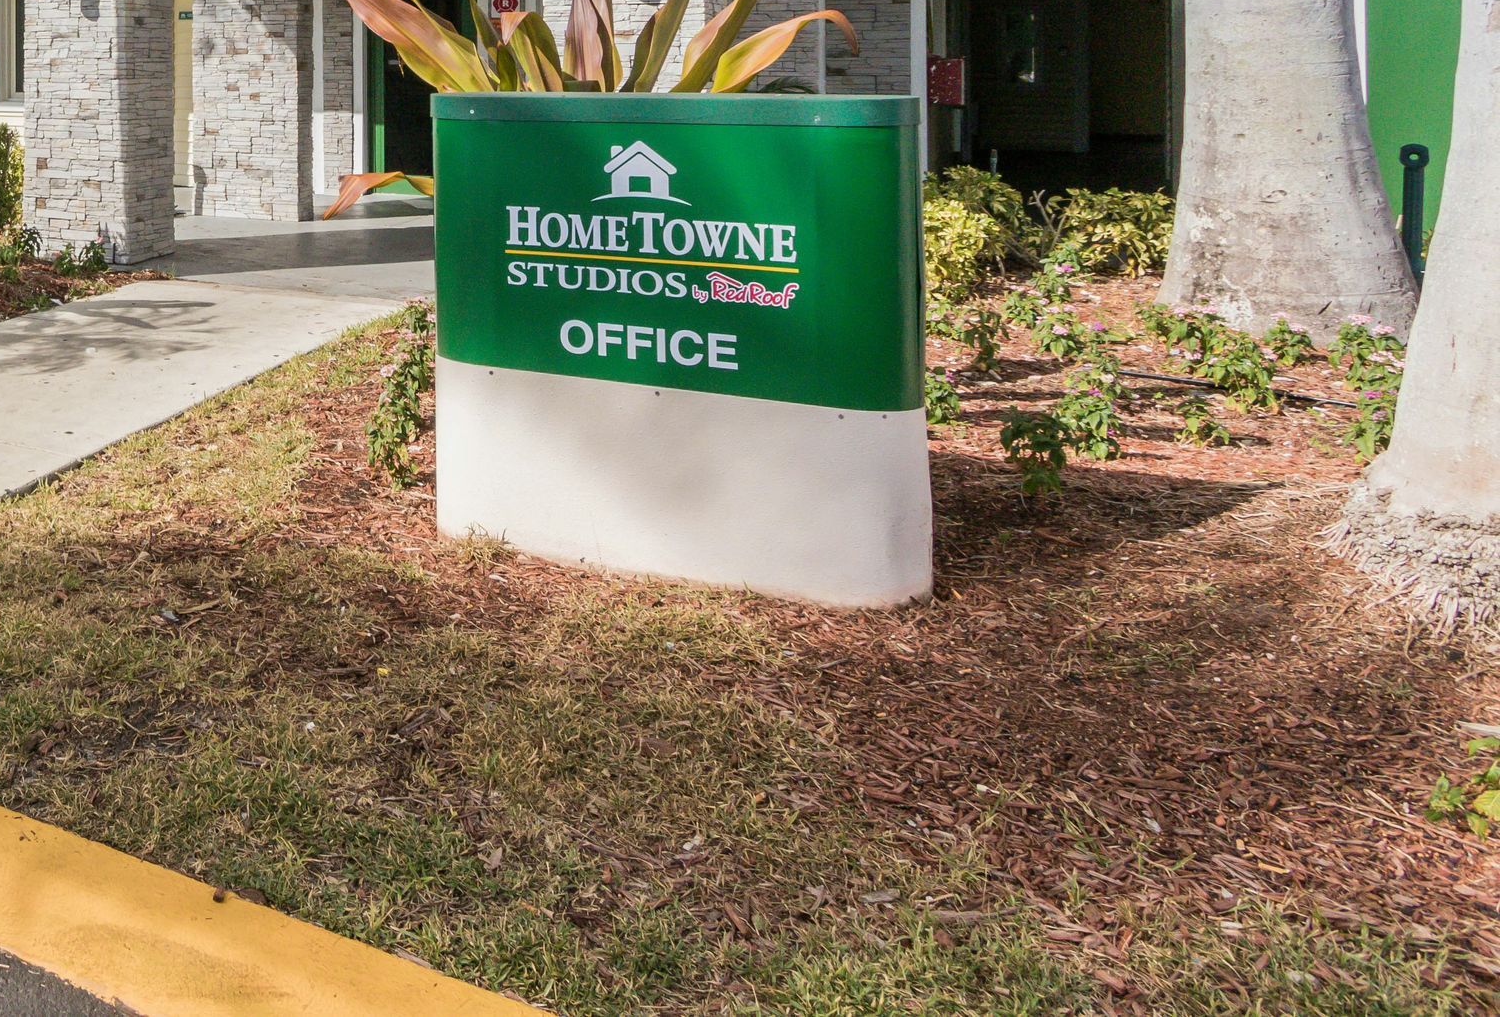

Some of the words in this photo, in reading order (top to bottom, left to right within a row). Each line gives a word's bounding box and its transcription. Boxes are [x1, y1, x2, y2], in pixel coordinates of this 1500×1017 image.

[506, 260, 688, 298] STUDIOS
[692, 284, 708, 303] by
[559, 319, 739, 370] OFFICE
